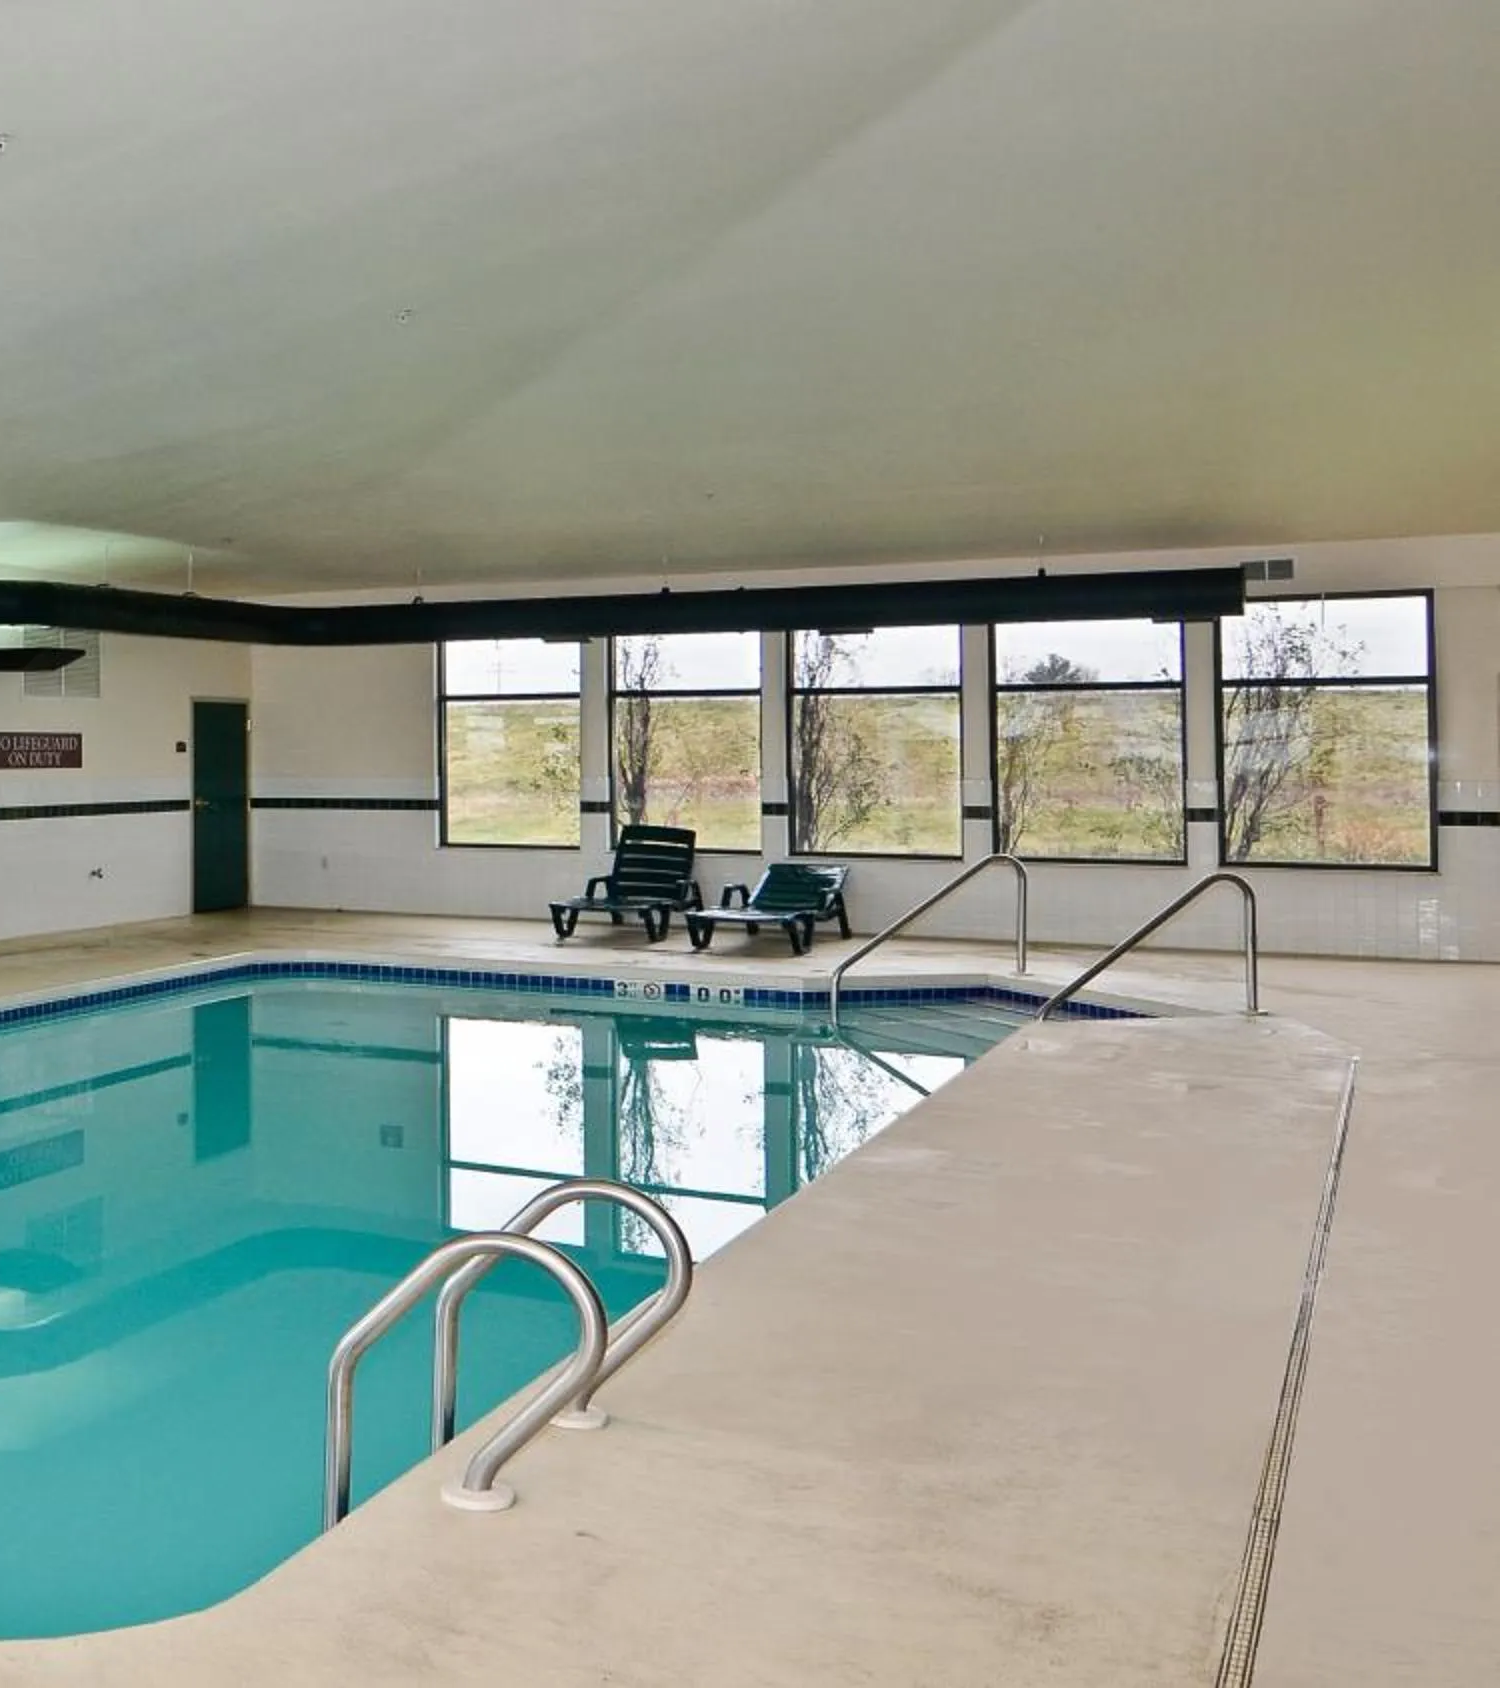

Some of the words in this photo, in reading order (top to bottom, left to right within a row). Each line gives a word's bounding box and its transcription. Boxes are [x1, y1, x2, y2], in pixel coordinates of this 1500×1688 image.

[13, 735, 78, 751] LIFEGUARD
[7, 751, 28, 766] ON
[29, 751, 63, 766] DUTY
